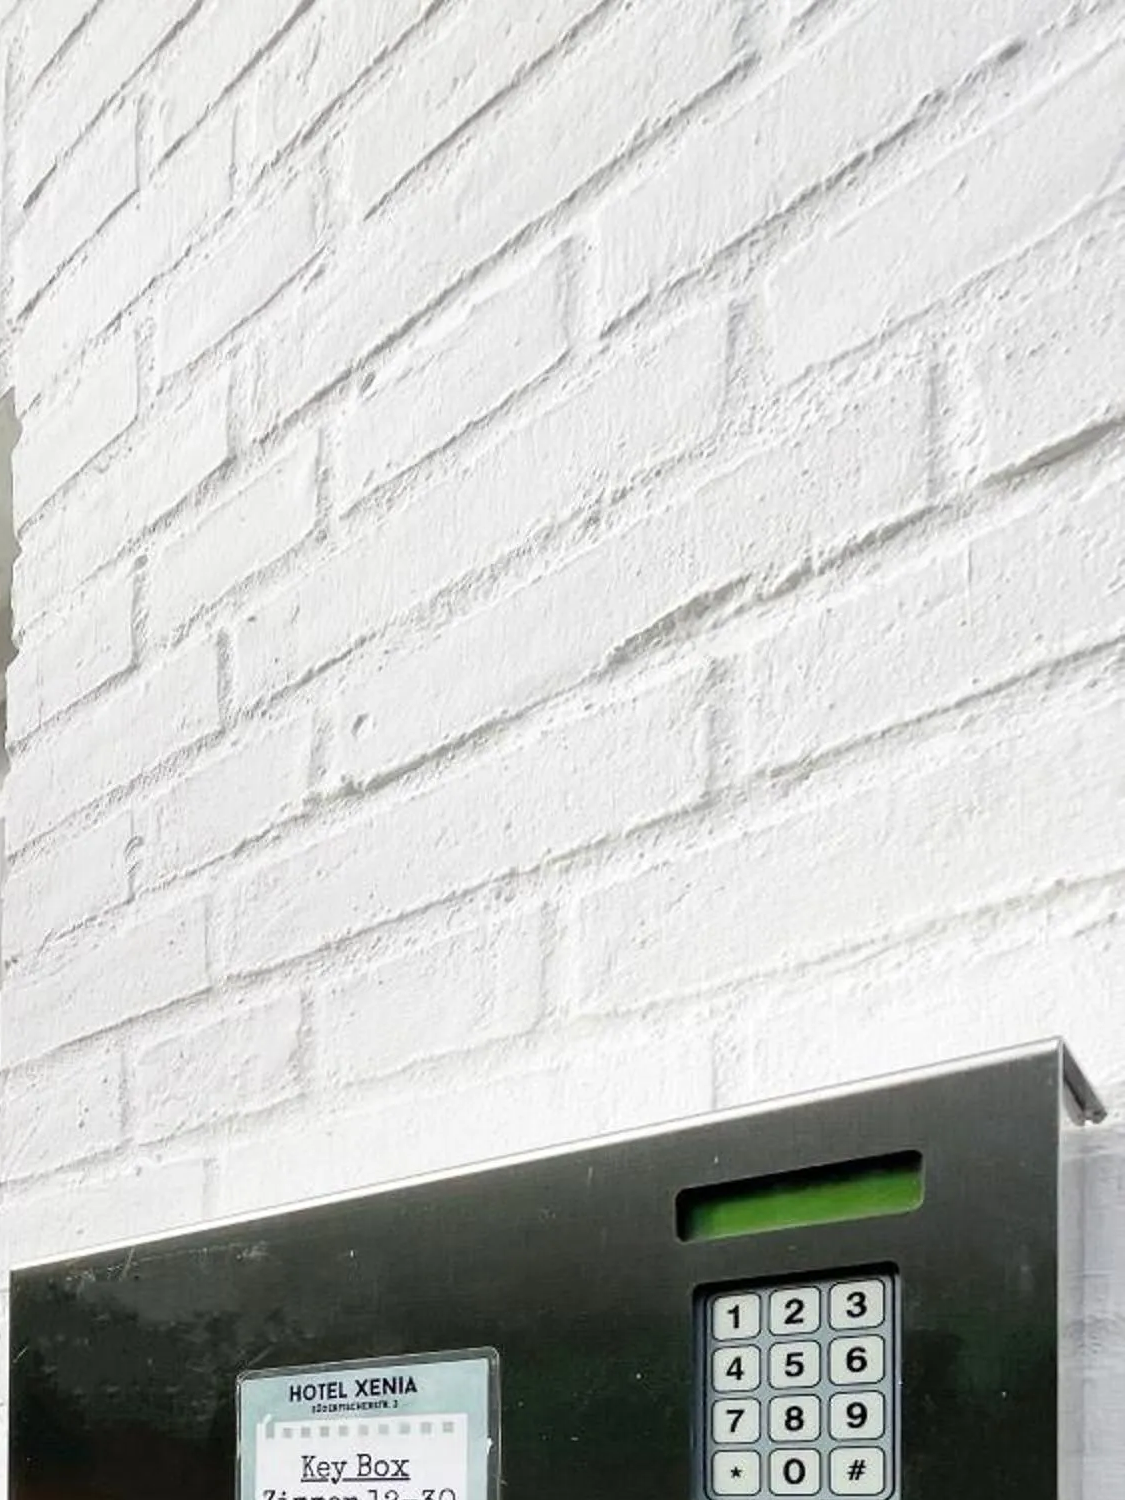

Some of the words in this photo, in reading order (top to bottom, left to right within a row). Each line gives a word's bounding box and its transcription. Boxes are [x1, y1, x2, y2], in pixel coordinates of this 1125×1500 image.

[727, 1304, 741, 1329] 1
[784, 1299, 805, 1325] 2
[846, 1291, 867, 1318] 3
[725, 1356, 744, 1381] 4
[784, 1352, 805, 1377] 5
[846, 1346, 868, 1373] 6
[289, 1382, 348, 1402] HOTEL
[354, 1376, 418, 1397] XENIA
[726, 1409, 745, 1433] 7
[784, 1405, 805, 1432] 8
[846, 1402, 868, 1429] 9
[301, 1455, 347, 1484] Key
[357, 1454, 411, 1478] Box
[783, 1458, 806, 1485] 0
